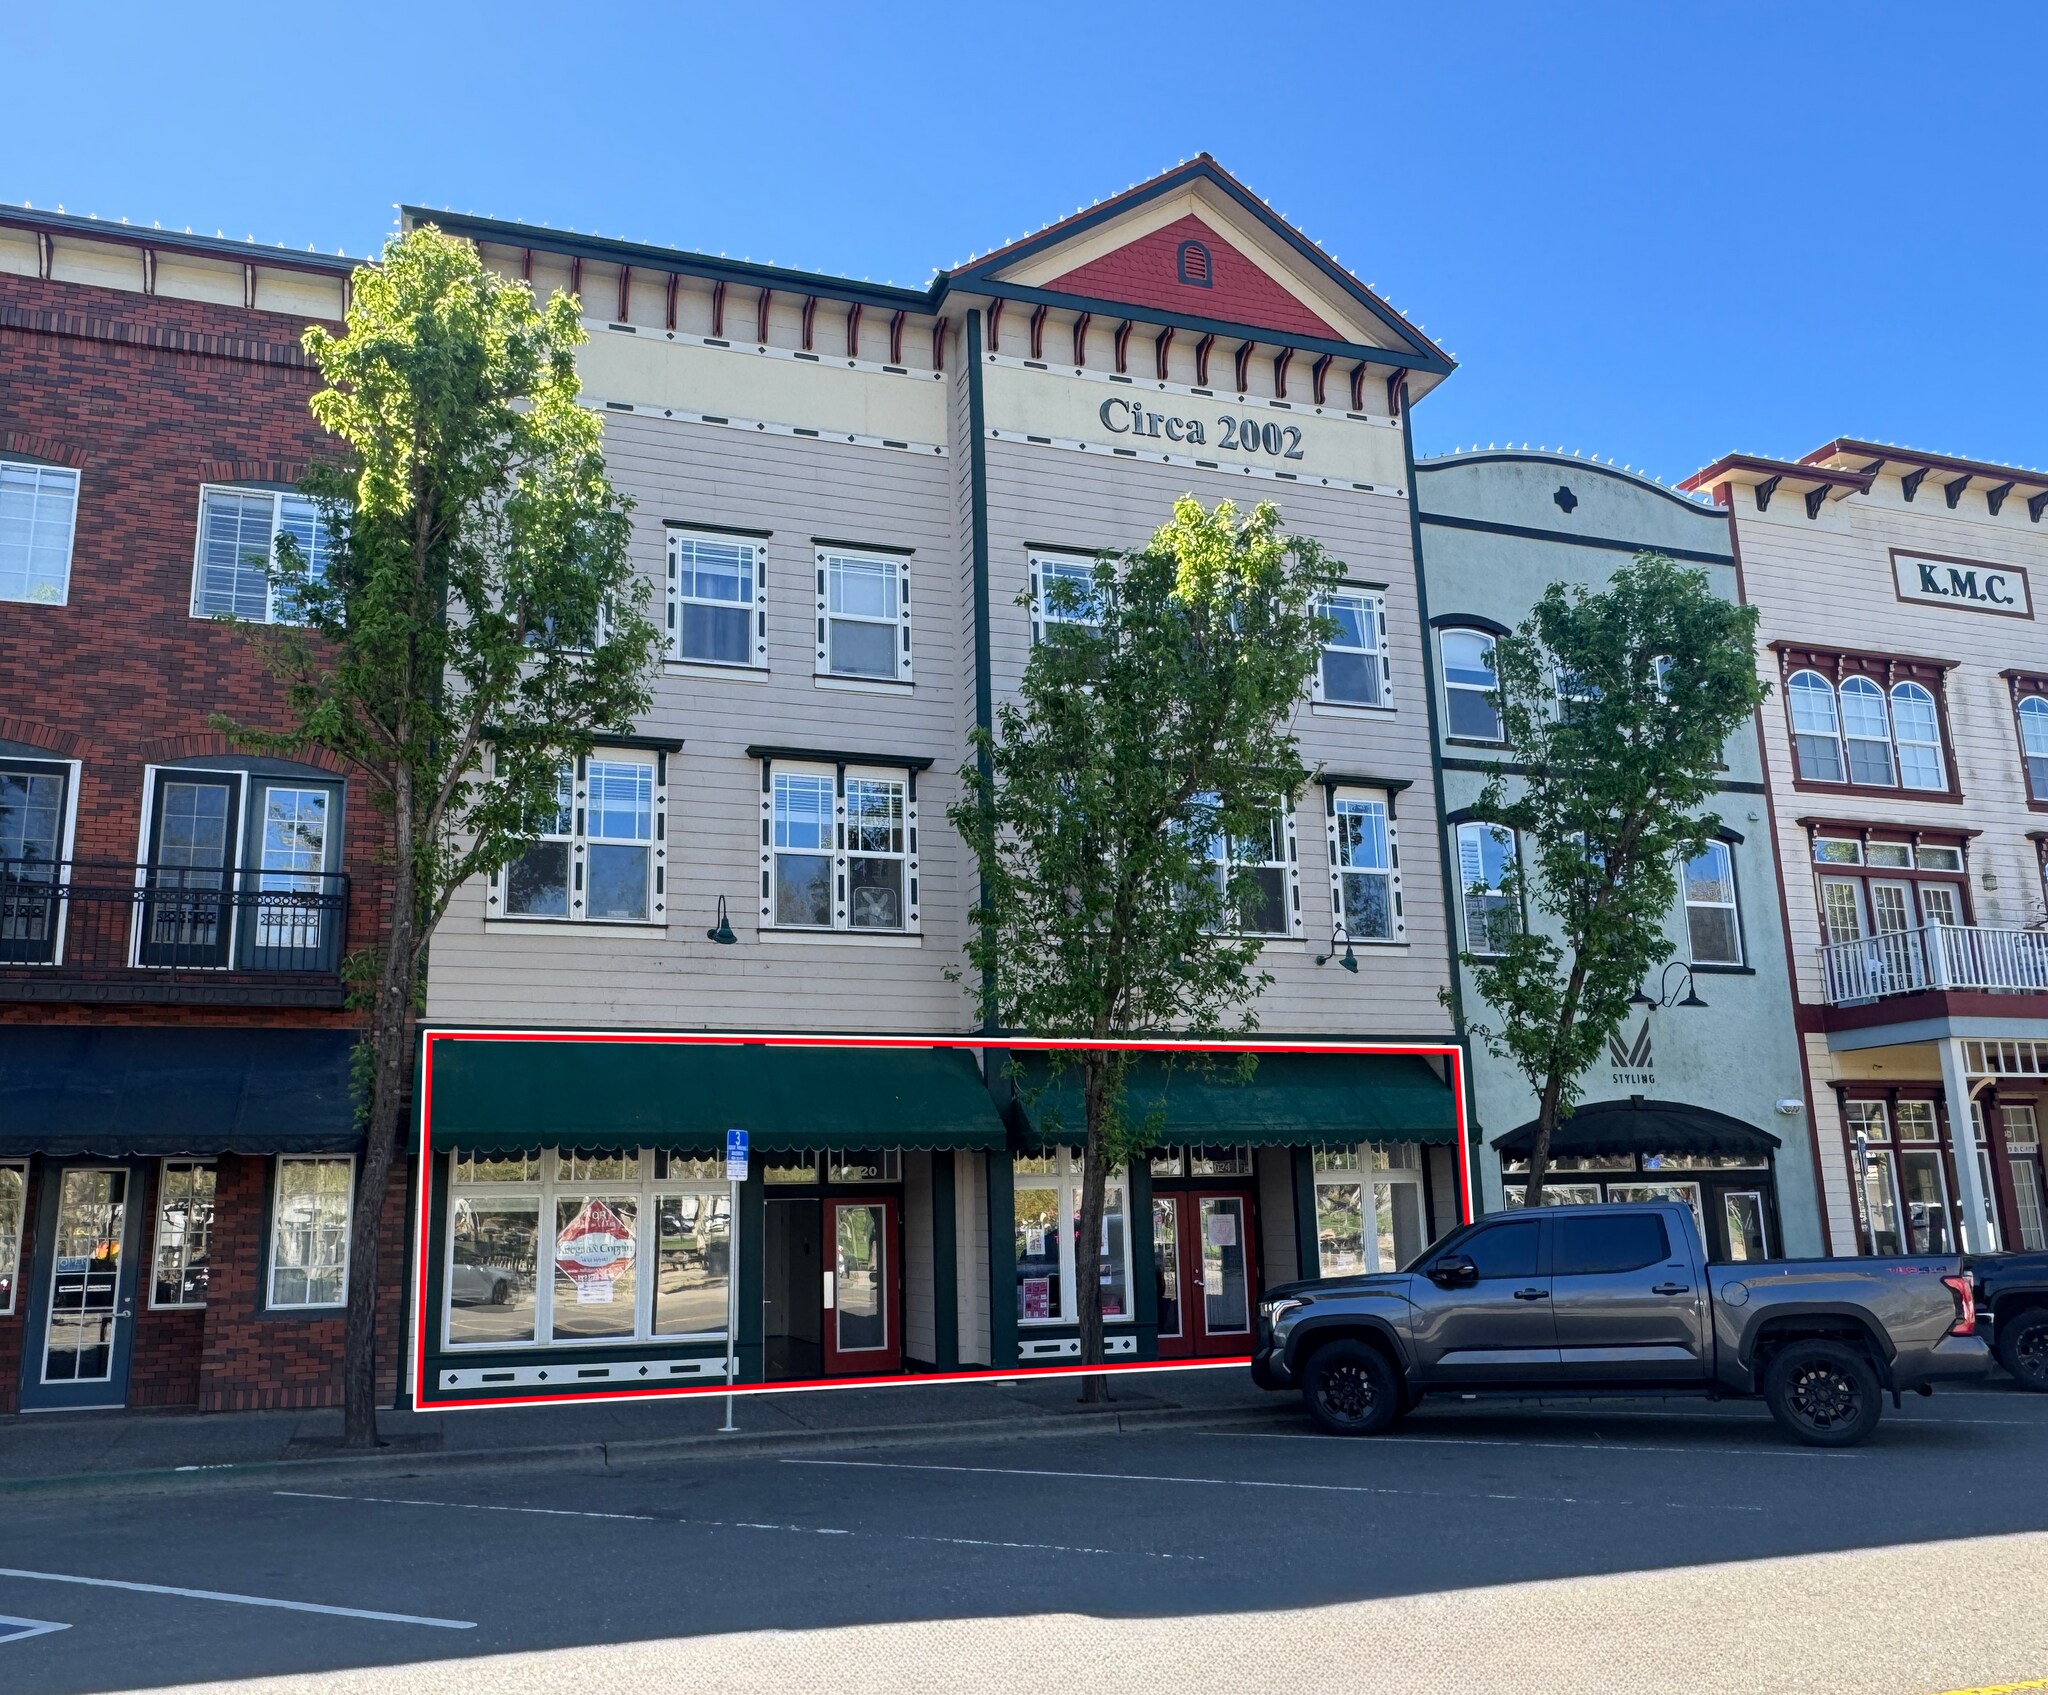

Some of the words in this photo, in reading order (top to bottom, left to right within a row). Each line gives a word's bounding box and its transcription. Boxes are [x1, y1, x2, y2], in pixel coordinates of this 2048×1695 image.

[1099, 397, 1207, 445] Circa
[1217, 415, 1305, 460] 2002
[1917, 563, 2014, 605] K.M.C.
[1612, 1073, 1656, 1084] STYLING
[735, 1131, 741, 1146] 3
